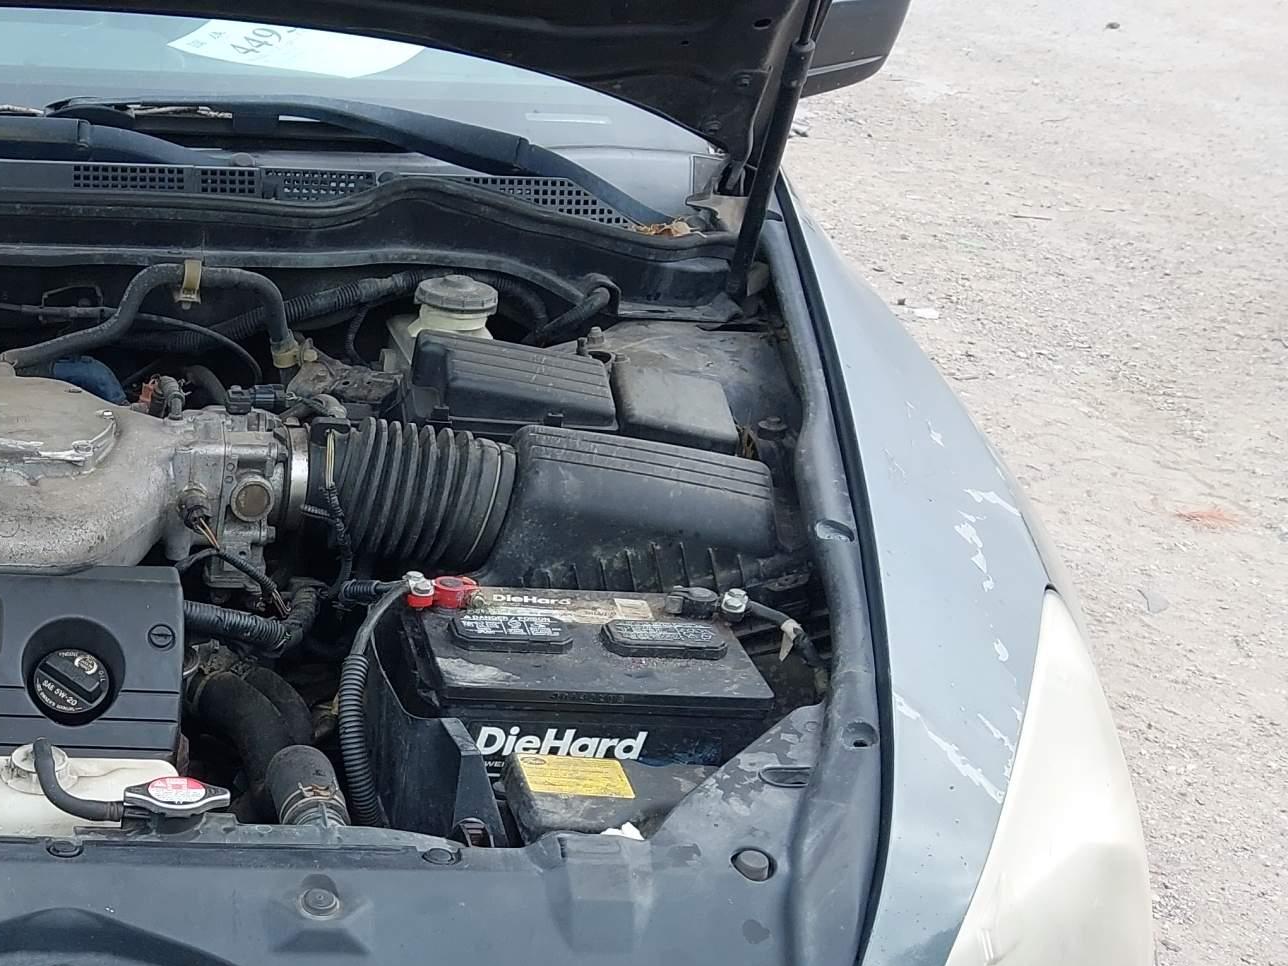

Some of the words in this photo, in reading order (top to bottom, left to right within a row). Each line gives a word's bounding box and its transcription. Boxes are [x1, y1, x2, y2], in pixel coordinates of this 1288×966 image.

[492, 594, 571, 605] DieHard
[42, 680, 55, 691] SAE
[54, 688, 78, 706] 5W-20
[476, 726, 649, 760] DieHard
